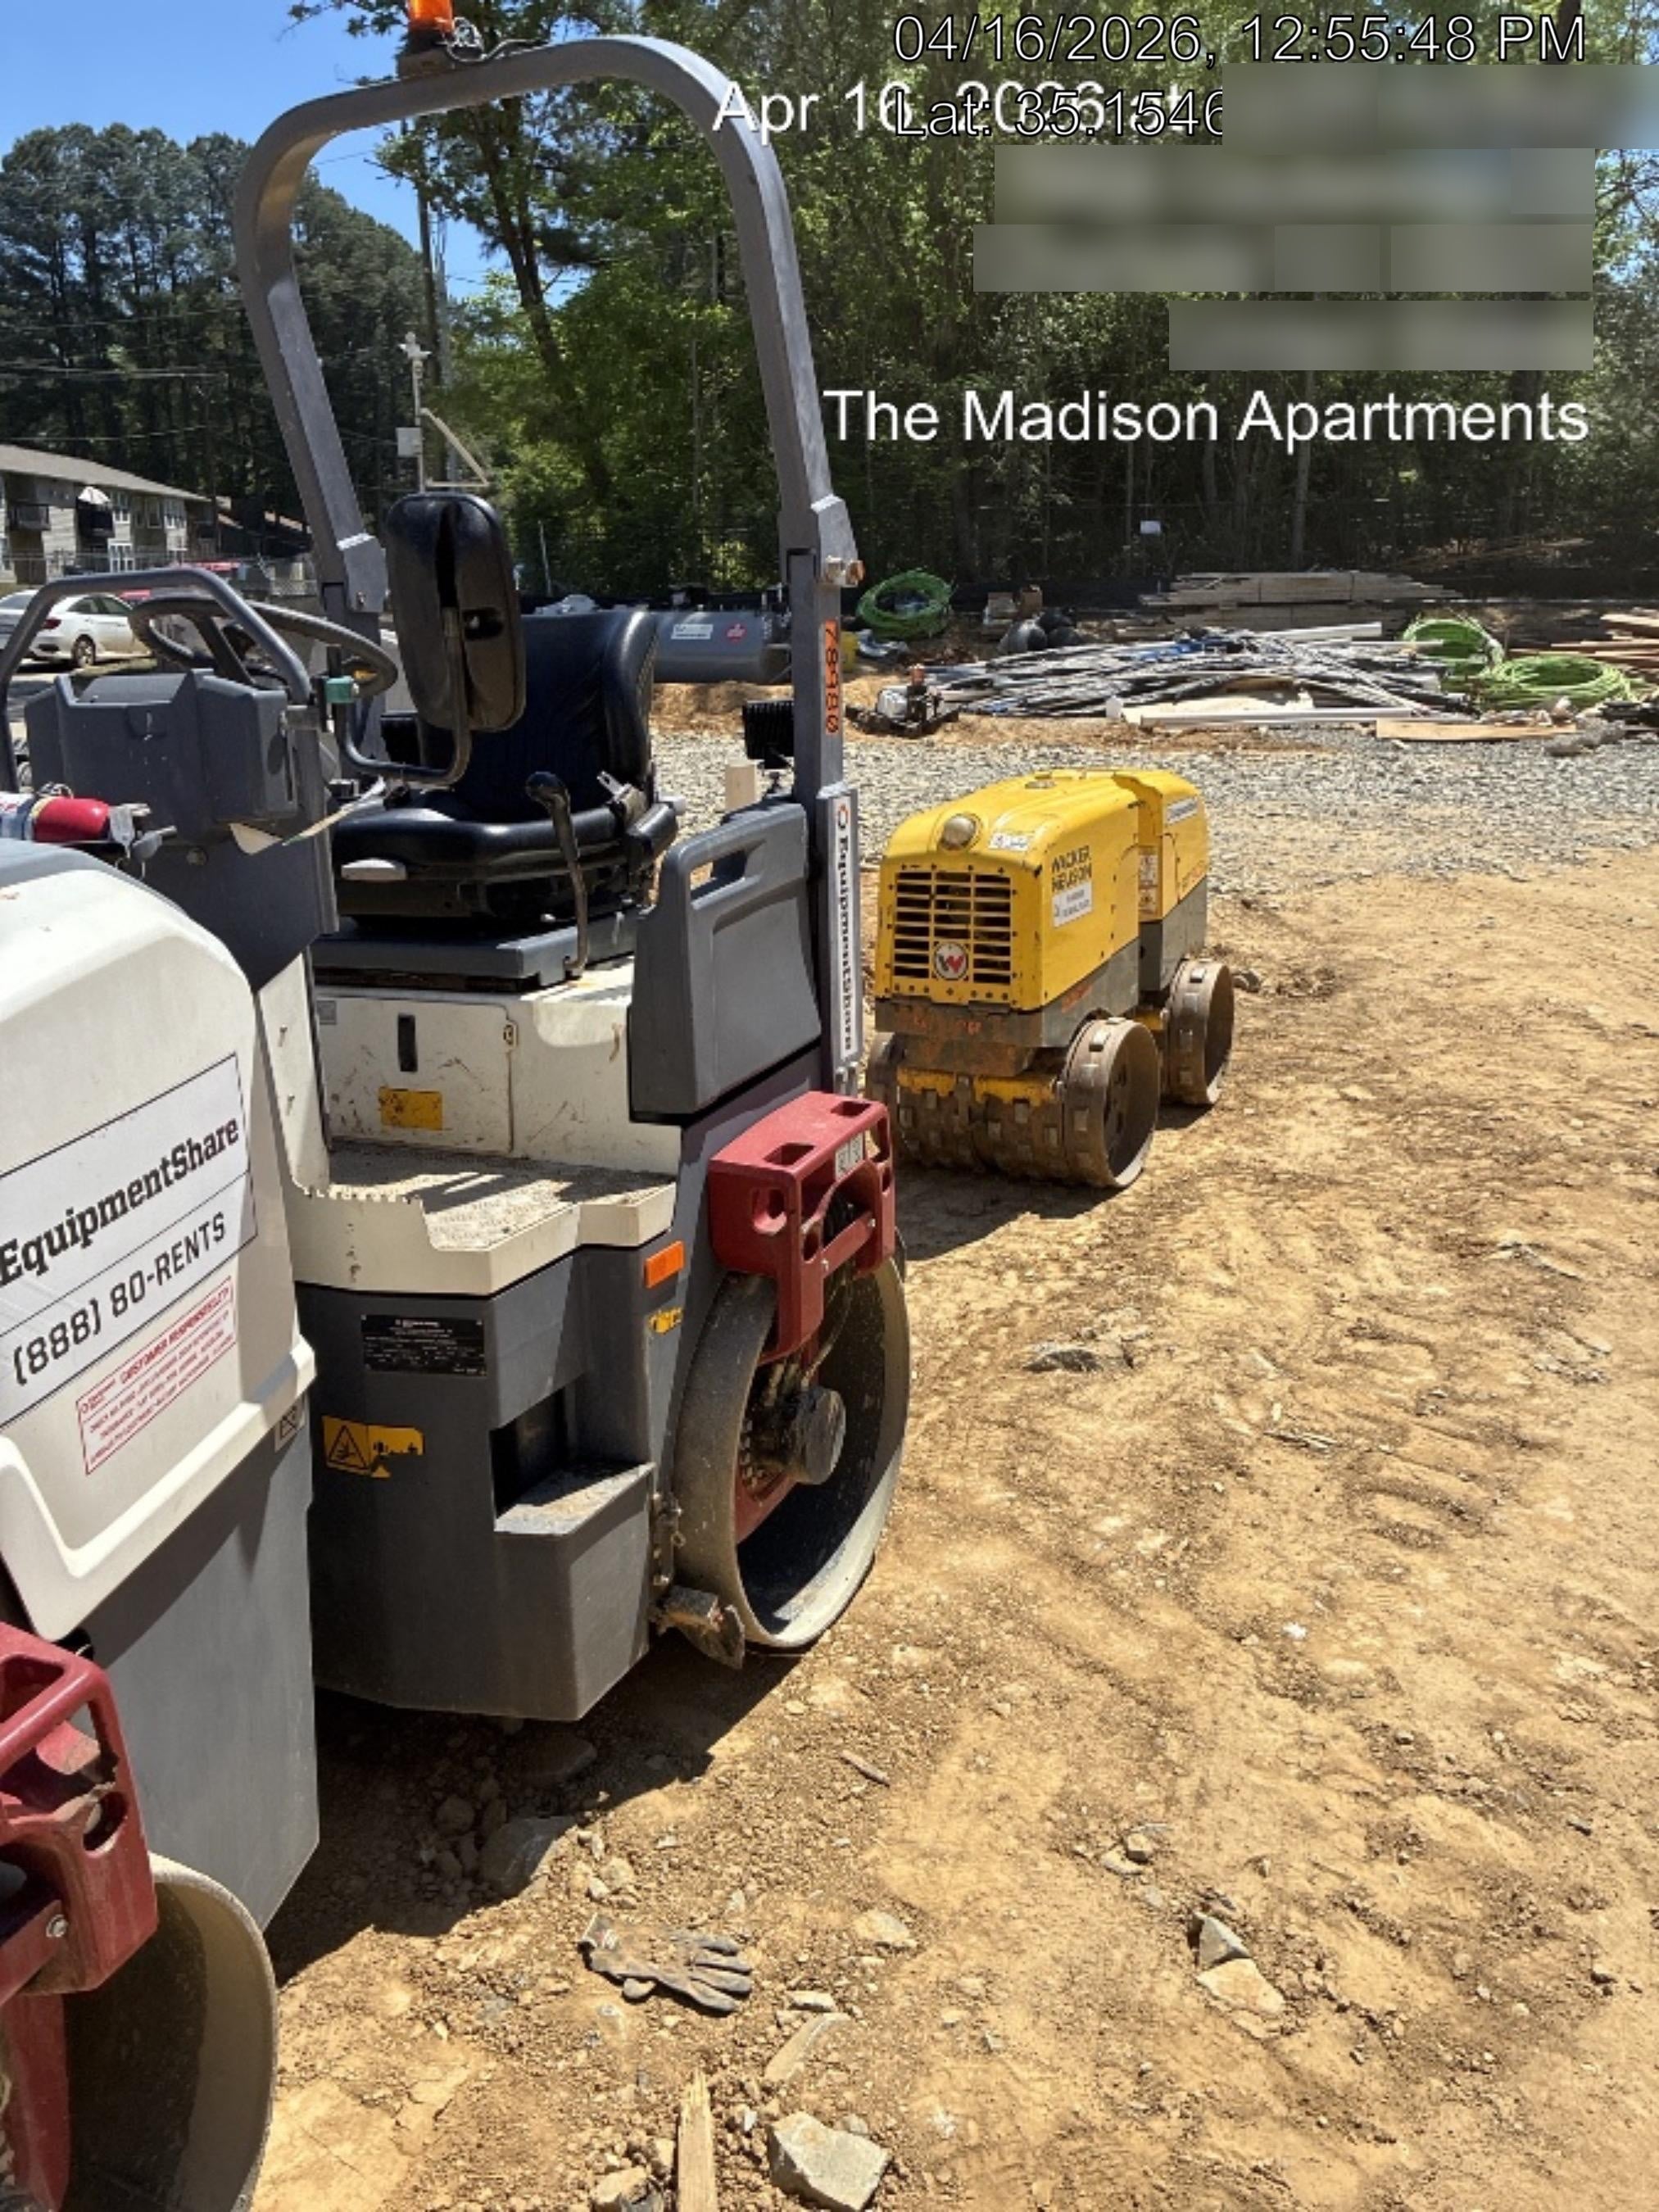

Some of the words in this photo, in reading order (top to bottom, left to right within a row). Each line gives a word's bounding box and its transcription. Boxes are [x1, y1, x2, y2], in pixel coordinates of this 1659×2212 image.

[837, 835, 854, 1053] EquipmentShare
[0, 1118, 239, 1287] EquipmentShare
[13, 1298, 102, 1385] (888)
[109, 1212, 225, 1318] 80-RENTS
